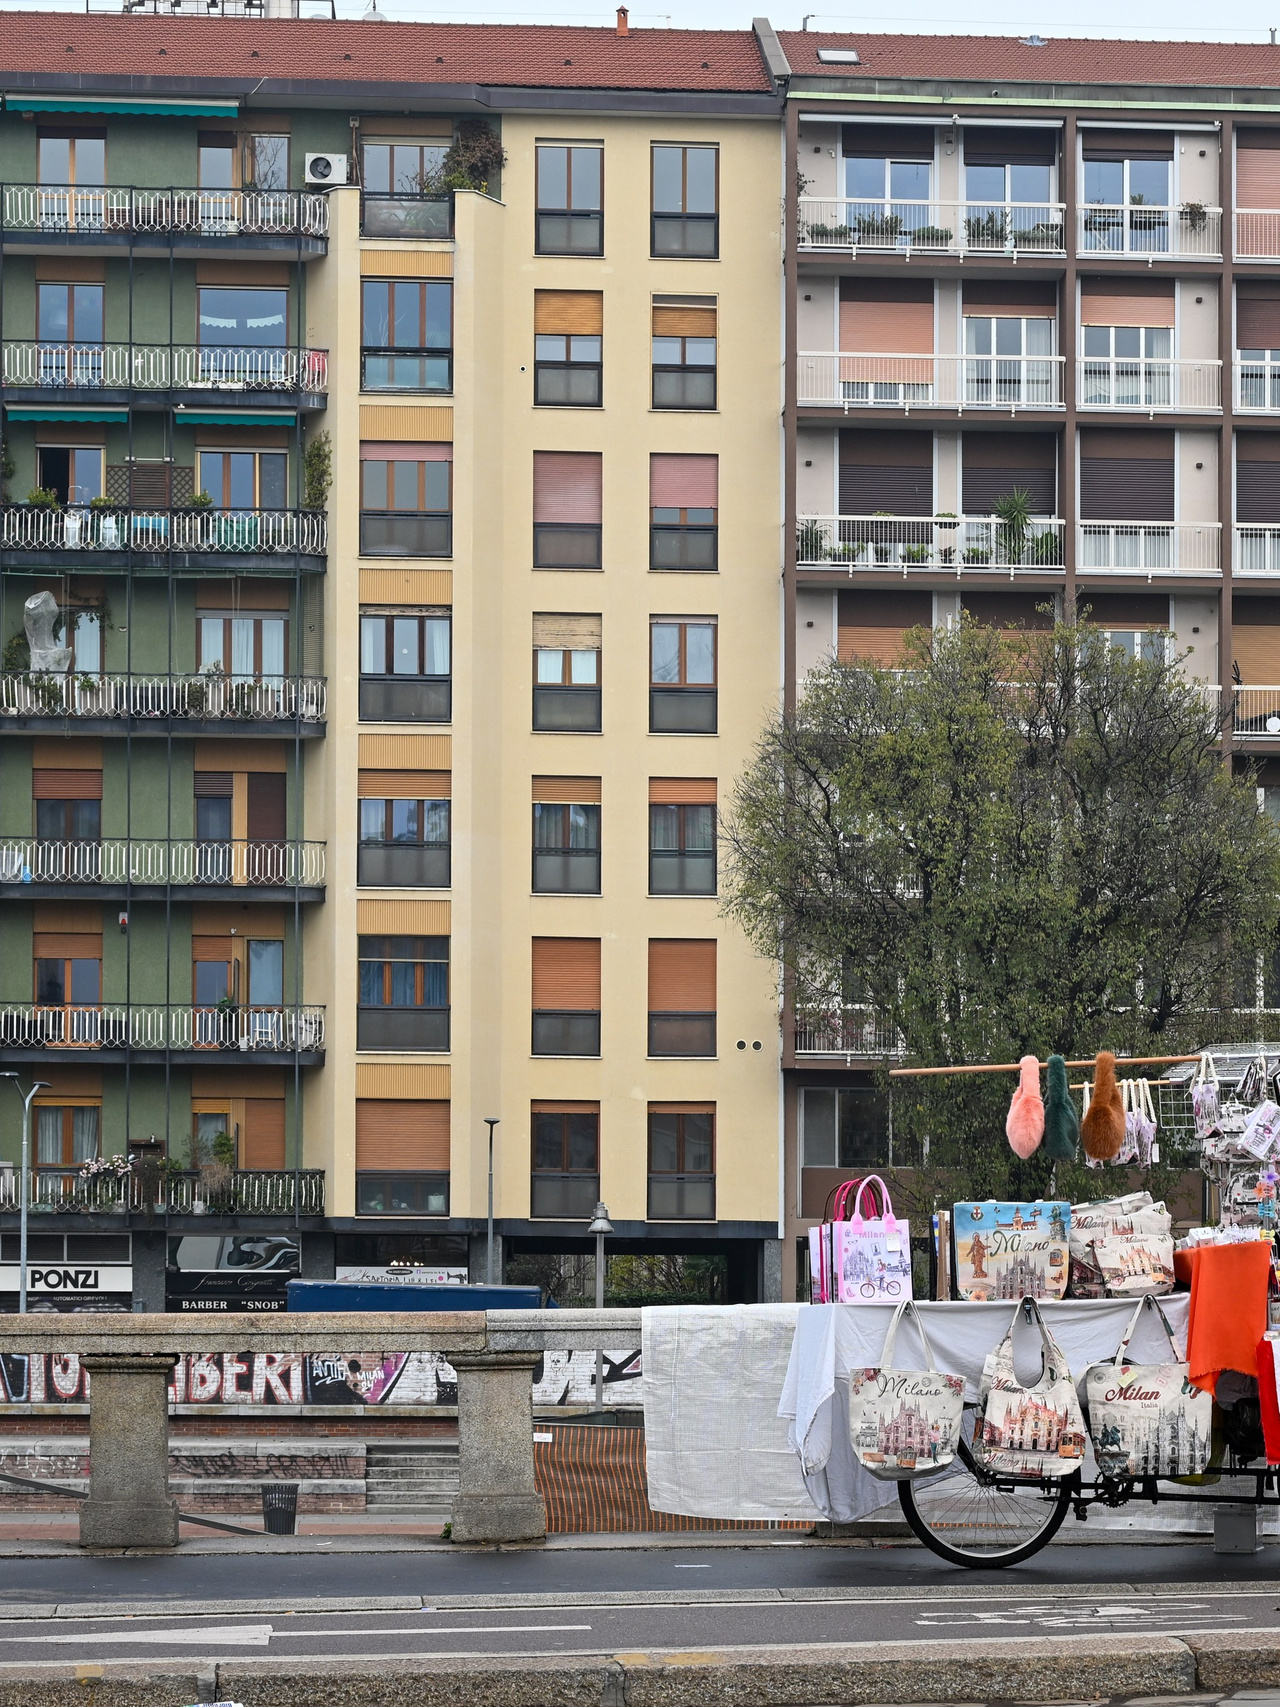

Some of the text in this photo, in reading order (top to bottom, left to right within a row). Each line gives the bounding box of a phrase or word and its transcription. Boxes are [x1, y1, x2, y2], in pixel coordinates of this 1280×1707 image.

[1071, 1216, 1109, 1229] Milano
[989, 1230, 1050, 1257] Milano
[31, 1269, 99, 1289] PONZI
[182, 1301, 228, 1309] BARBER
[876, 1373, 943, 1398] Milano
[990, 1376, 1027, 1394] Milano
[1105, 1385, 1161, 1402] Milan
